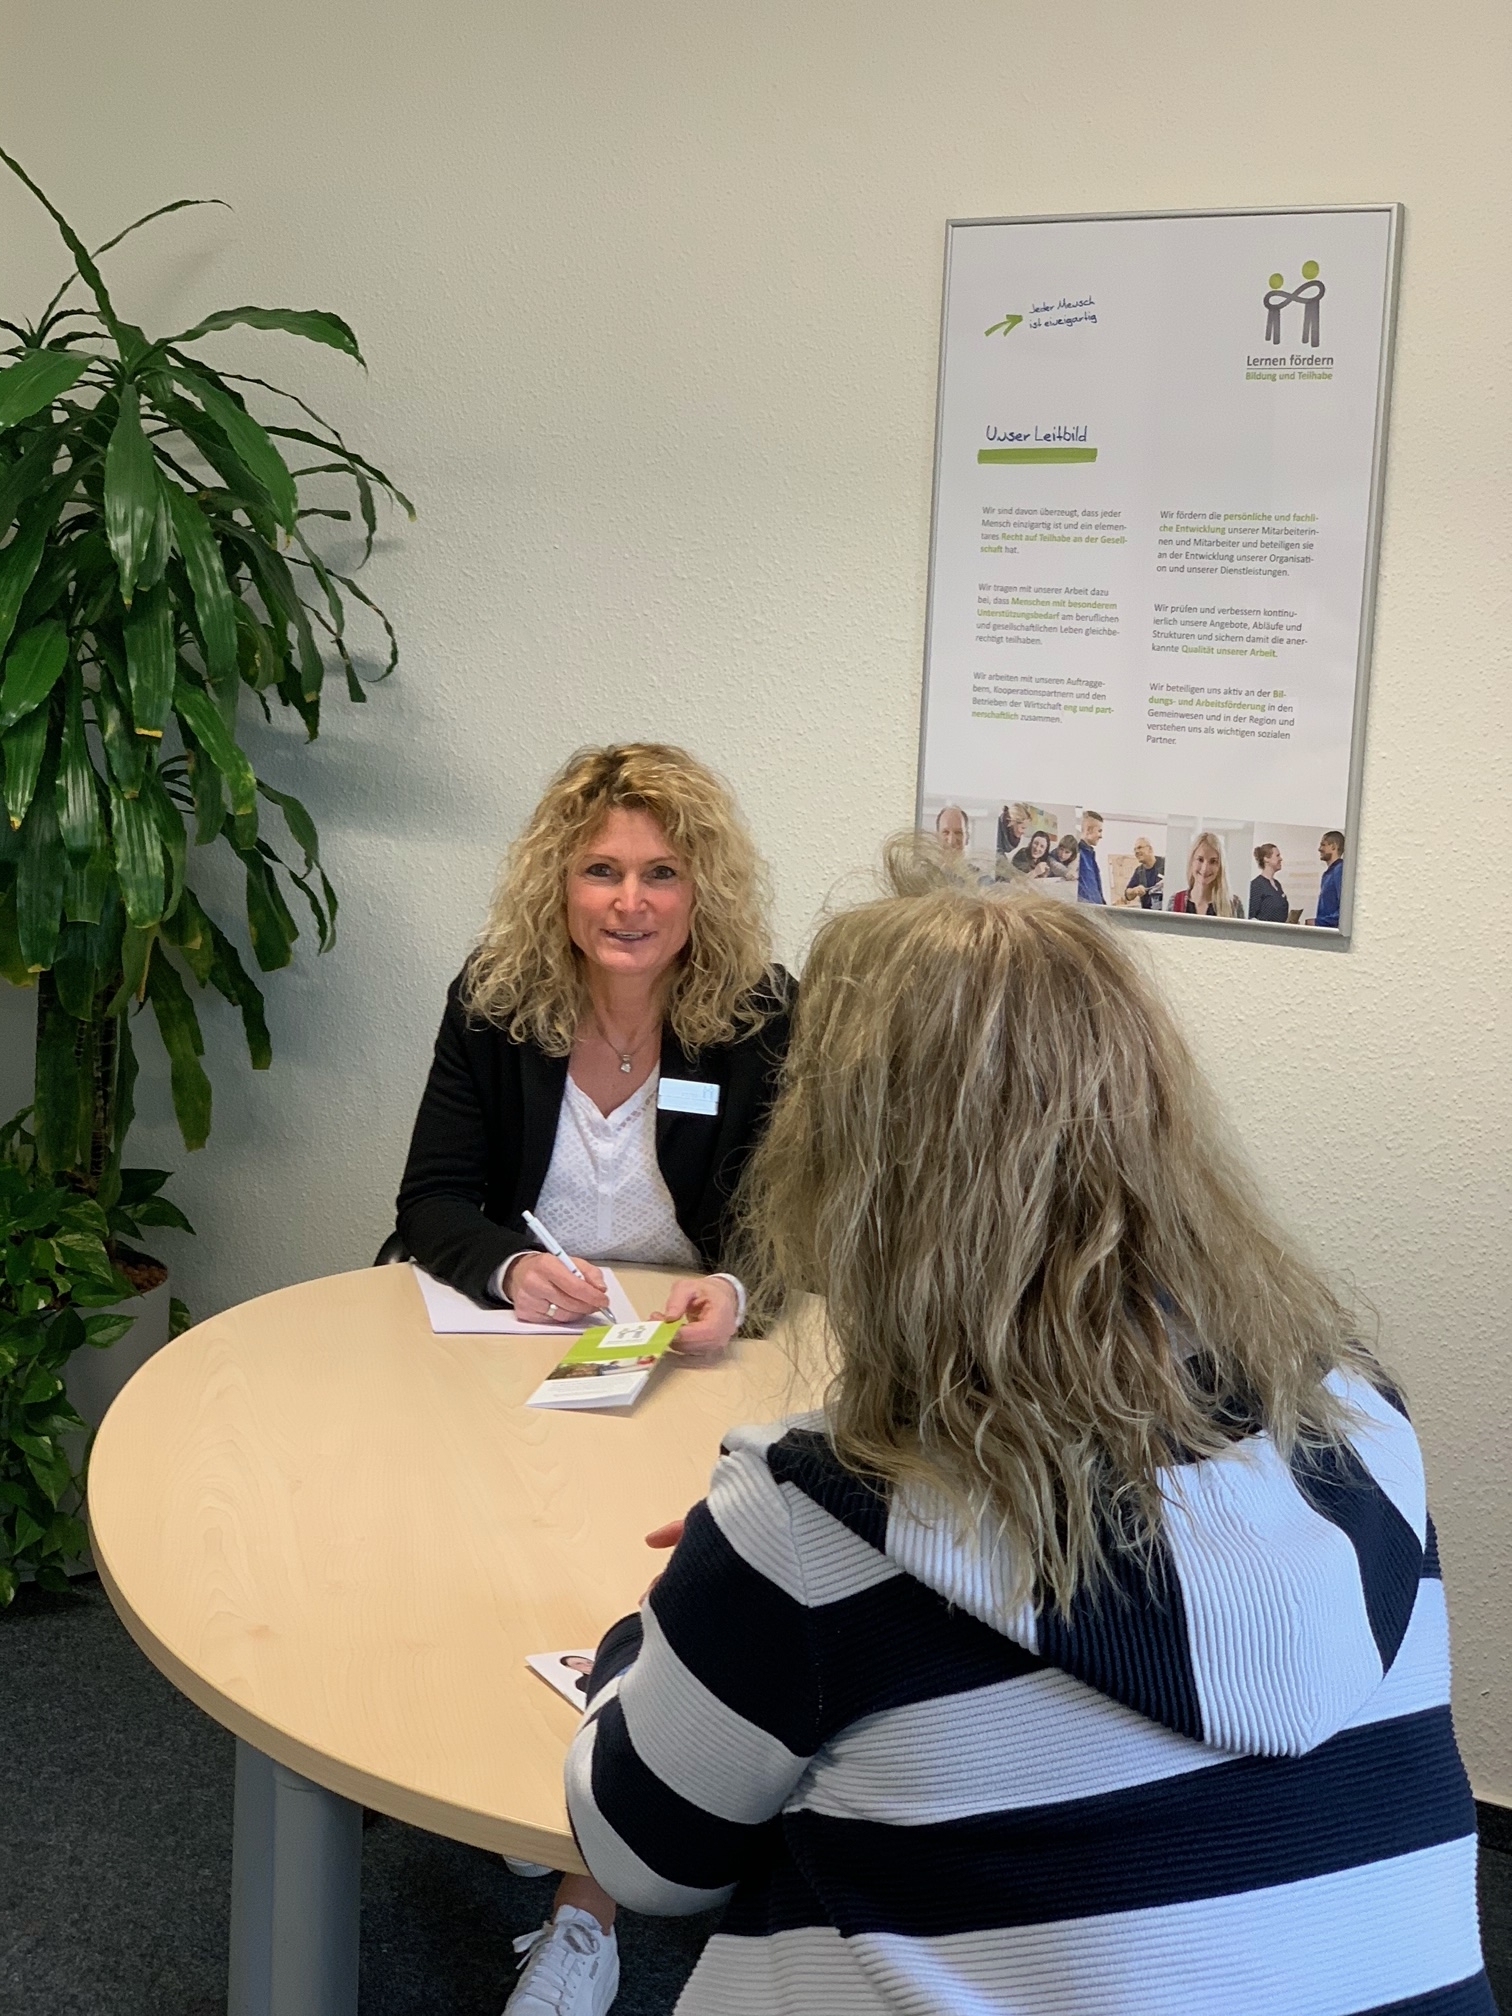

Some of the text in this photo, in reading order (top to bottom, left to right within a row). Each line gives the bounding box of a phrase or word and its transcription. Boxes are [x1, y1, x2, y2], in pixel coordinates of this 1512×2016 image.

[1029, 318, 1041, 329] ist
[1247, 355, 1333, 366] Lernen fördern
[1246, 371, 1333, 381] Bildung und Teilhabe
[1035, 425, 1088, 441] Leitbild
[982, 506, 995, 515] Wir
[997, 506, 1013, 515] sind
[1014, 507, 1038, 516] davon
[1081, 508, 1098, 517] dass
[1100, 509, 1121, 519] jeder
[1160, 510, 1318, 522] Wir fördern die persönliche und fachli-
[981, 518, 1127, 530] Mensch einzigartig ist und ein elemen-
[1159, 524, 1173, 533] che
[1175, 524, 1226, 536] Entwicklung
[1001, 532, 1023, 541] Recht
[1025, 533, 1038, 541] auf
[1039, 533, 1071, 542] Teilhabe
[1084, 534, 1098, 543] der
[1100, 535, 1128, 544] Gesell-
[1175, 538, 1191, 546] und
[1193, 538, 1240, 548] Mitarbeiter
[1242, 540, 1258, 548] und
[1260, 540, 1300, 551] beteiligen
[1302, 541, 1314, 549] sie
[980, 544, 1019, 554] schaft hat.
[1169, 551, 1182, 560] der
[1185, 551, 1234, 563] Entwicklung
[1169, 565, 1185, 573] und
[1220, 566, 1290, 578] Dienstleistungen.
[978, 583, 991, 592] Wir
[993, 584, 1017, 594] tragen
[1019, 585, 1032, 593] mit
[1064, 586, 1088, 595] Arbeit
[1090, 587, 1109, 596] dazu
[978, 596, 1117, 609] bei, dass Menschen mit besonderem
[1075, 612, 1119, 622] beruflichen
[1154, 604, 1297, 617] Wir prüfen und verbessern kontinu-
[976, 621, 991, 630] und
[1060, 625, 1083, 634] Leben
[1085, 626, 1120, 636] gleichbe-
[1153, 616, 1302, 631] ierlich unsere Angebote, Abläufe und
[1005, 636, 1042, 645] teilhaben.
[1152, 631, 1308, 645] Strukturen und sichern damit die aner-
[1152, 643, 1278, 657] kannte Qualität unserer Arbeit.
[973, 671, 986, 680] Wir
[988, 672, 1018, 682] arbeiten
[1020, 674, 1033, 683] mit
[1034, 677, 1065, 685] unseren
[1076, 691, 1090, 699] und
[1092, 691, 1106, 700] den
[1149, 682, 1163, 691] Wir
[1166, 683, 1205, 695] beteiligen
[1223, 687, 1242, 696] aktiv
[1257, 688, 1270, 697] der
[1272, 689, 1286, 698] Bil-
[972, 697, 1115, 715] Betrieben der Wirtschaft eng und part-
[1148, 696, 1293, 712] dungs- und Arbeitsförderung in den
[1020, 714, 1063, 723] zusammen.
[1148, 709, 1295, 725] Gemeinwesen und in der Region und
[1146, 723, 1186, 732] verstehen
[1203, 725, 1215, 734] als
[1216, 726, 1255, 738] wichtigen
[1257, 729, 1291, 738] sozialen
[1146, 735, 1176, 745] Partner.
